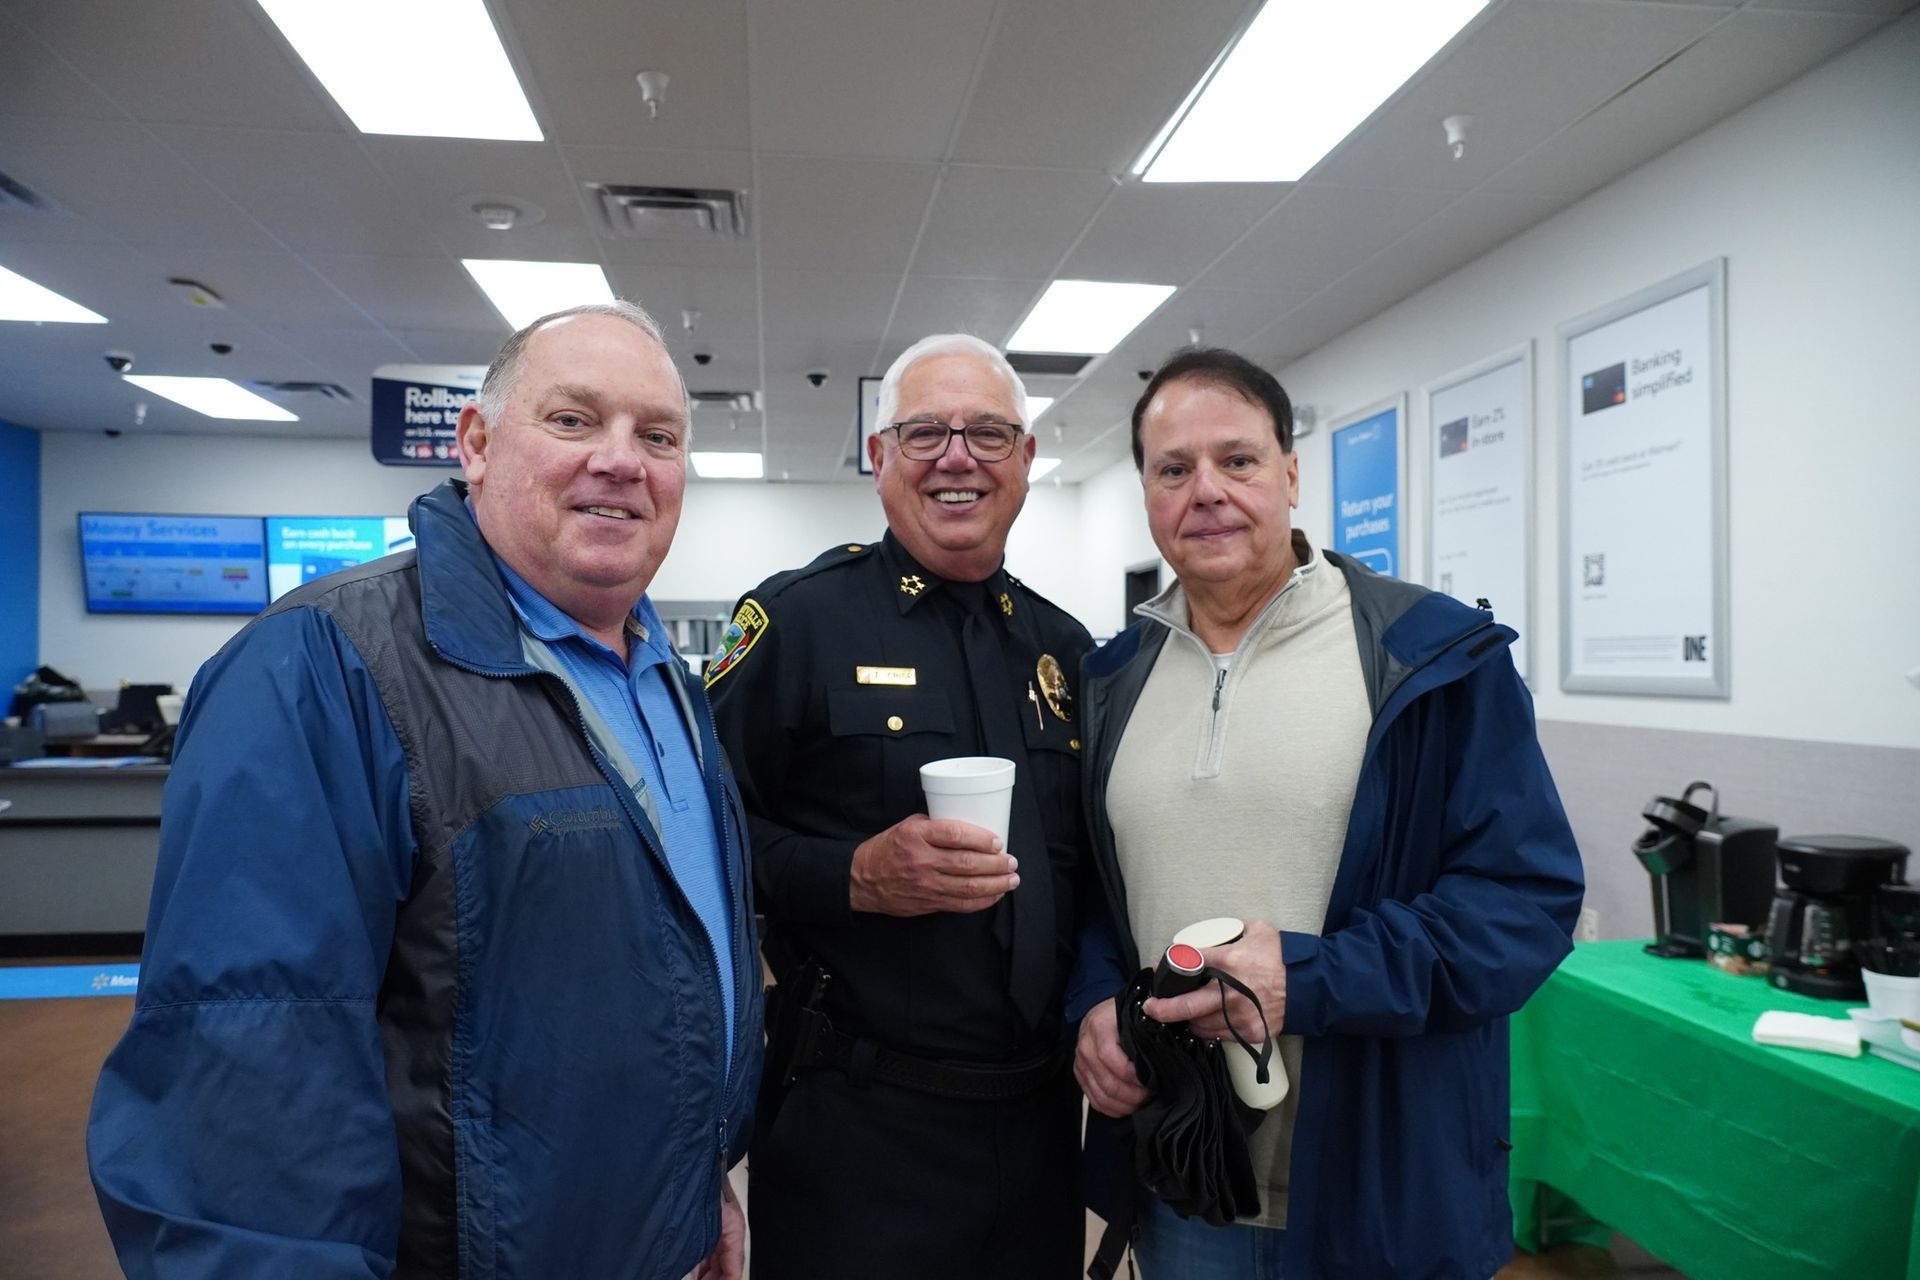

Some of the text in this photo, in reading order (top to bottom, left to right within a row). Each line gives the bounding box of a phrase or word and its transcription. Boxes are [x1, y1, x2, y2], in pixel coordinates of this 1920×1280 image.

[1631, 348, 1681, 376] Banking
[1631, 366, 1694, 400] simplified
[404, 408, 442, 424] here
[147, 519, 218, 537] Services
[1345, 517, 1391, 544] purchases
